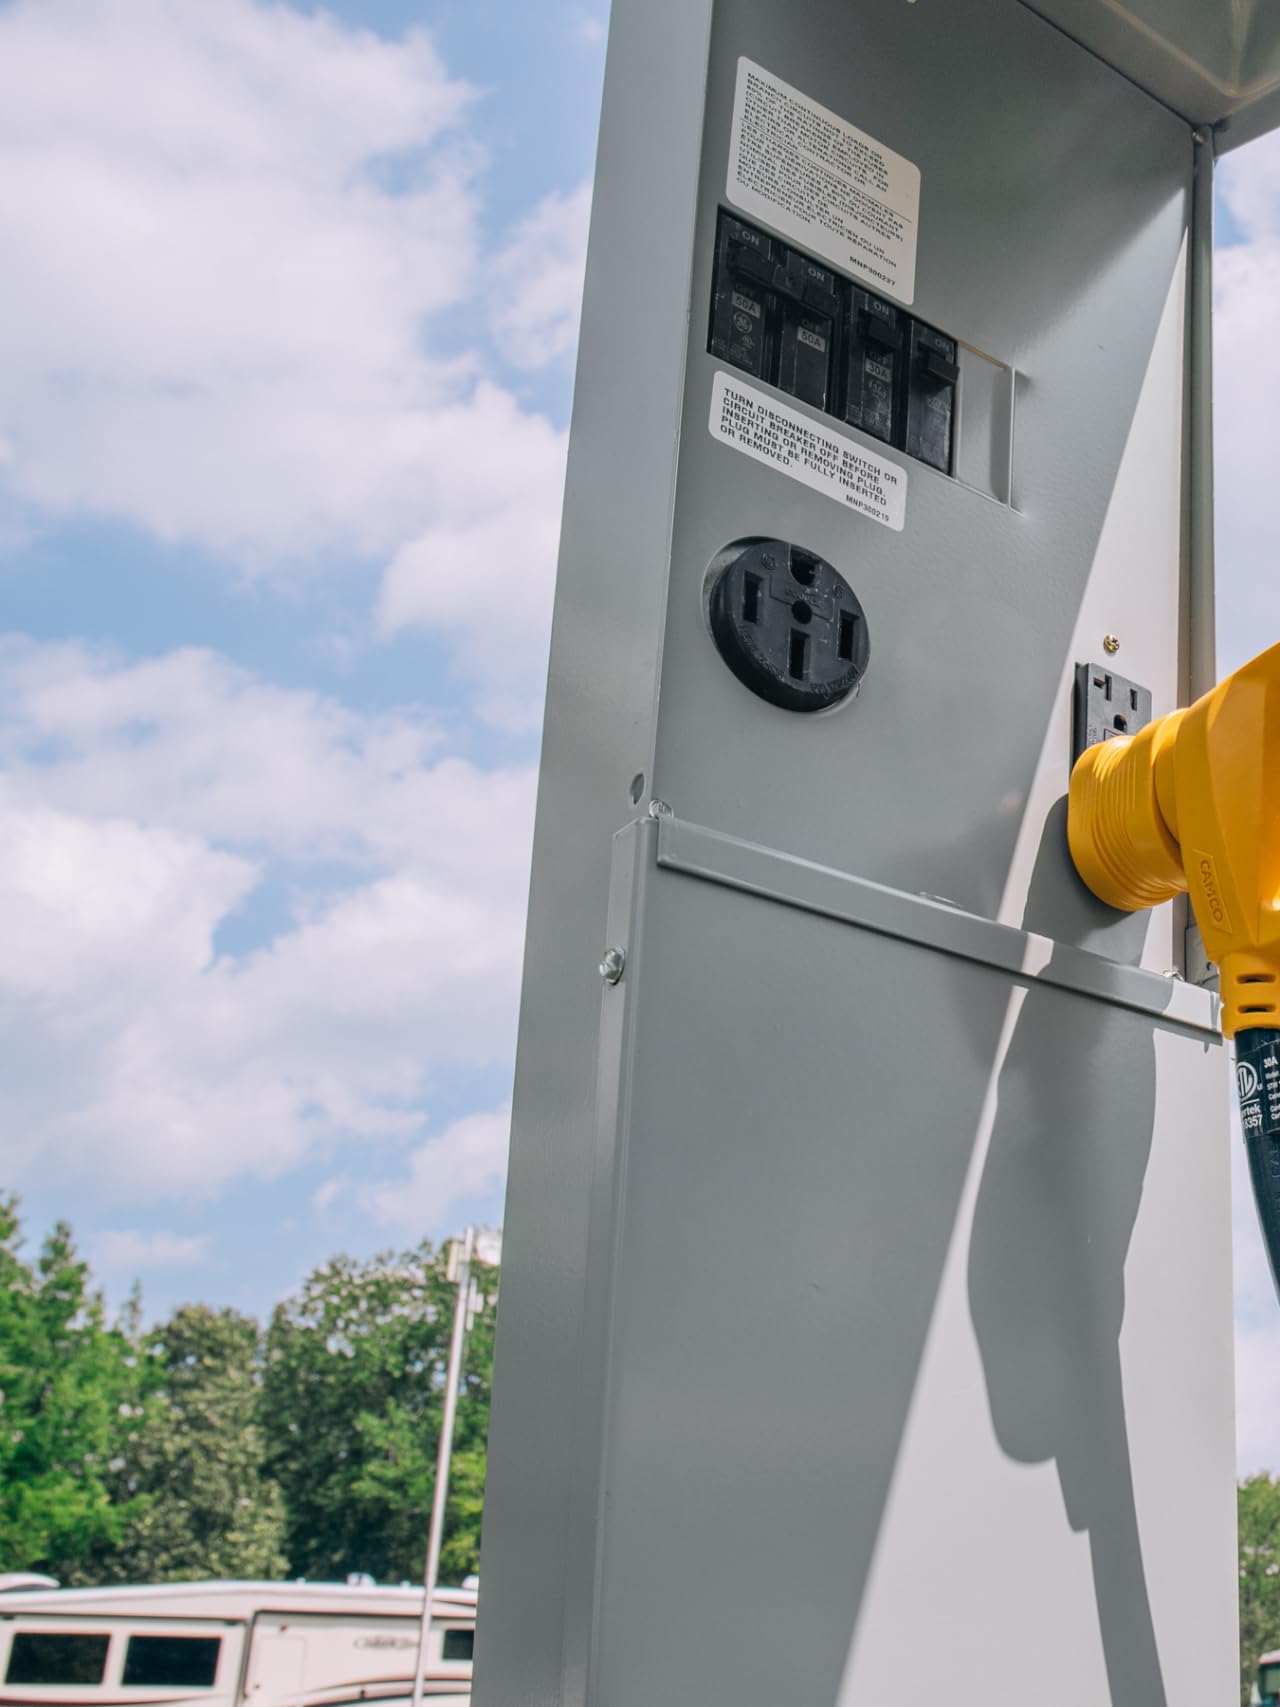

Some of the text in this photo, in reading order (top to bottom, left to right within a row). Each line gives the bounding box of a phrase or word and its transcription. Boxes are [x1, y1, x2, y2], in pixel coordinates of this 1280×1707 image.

[742, 231, 759, 246] ON
[808, 267, 825, 282] ON
[873, 302, 889, 316] ON
[720, 423, 735, 438] OR
[723, 387, 753, 409] TURN
[757, 404, 838, 454] DISCONNECTING
[842, 449, 880, 476] SWITCH
[884, 471, 896, 485] OR
[723, 396, 879, 485] CIRCUIT BREAKER OFF BEFORE
[721, 414, 886, 506] PLUG MUST BE FULLY INSERTED
[722, 405, 886, 497] INSERTING OR REMOVING PLUG.
[1200, 860, 1223, 922] CAMCO
[1264, 1056, 1278, 1068] 30A
